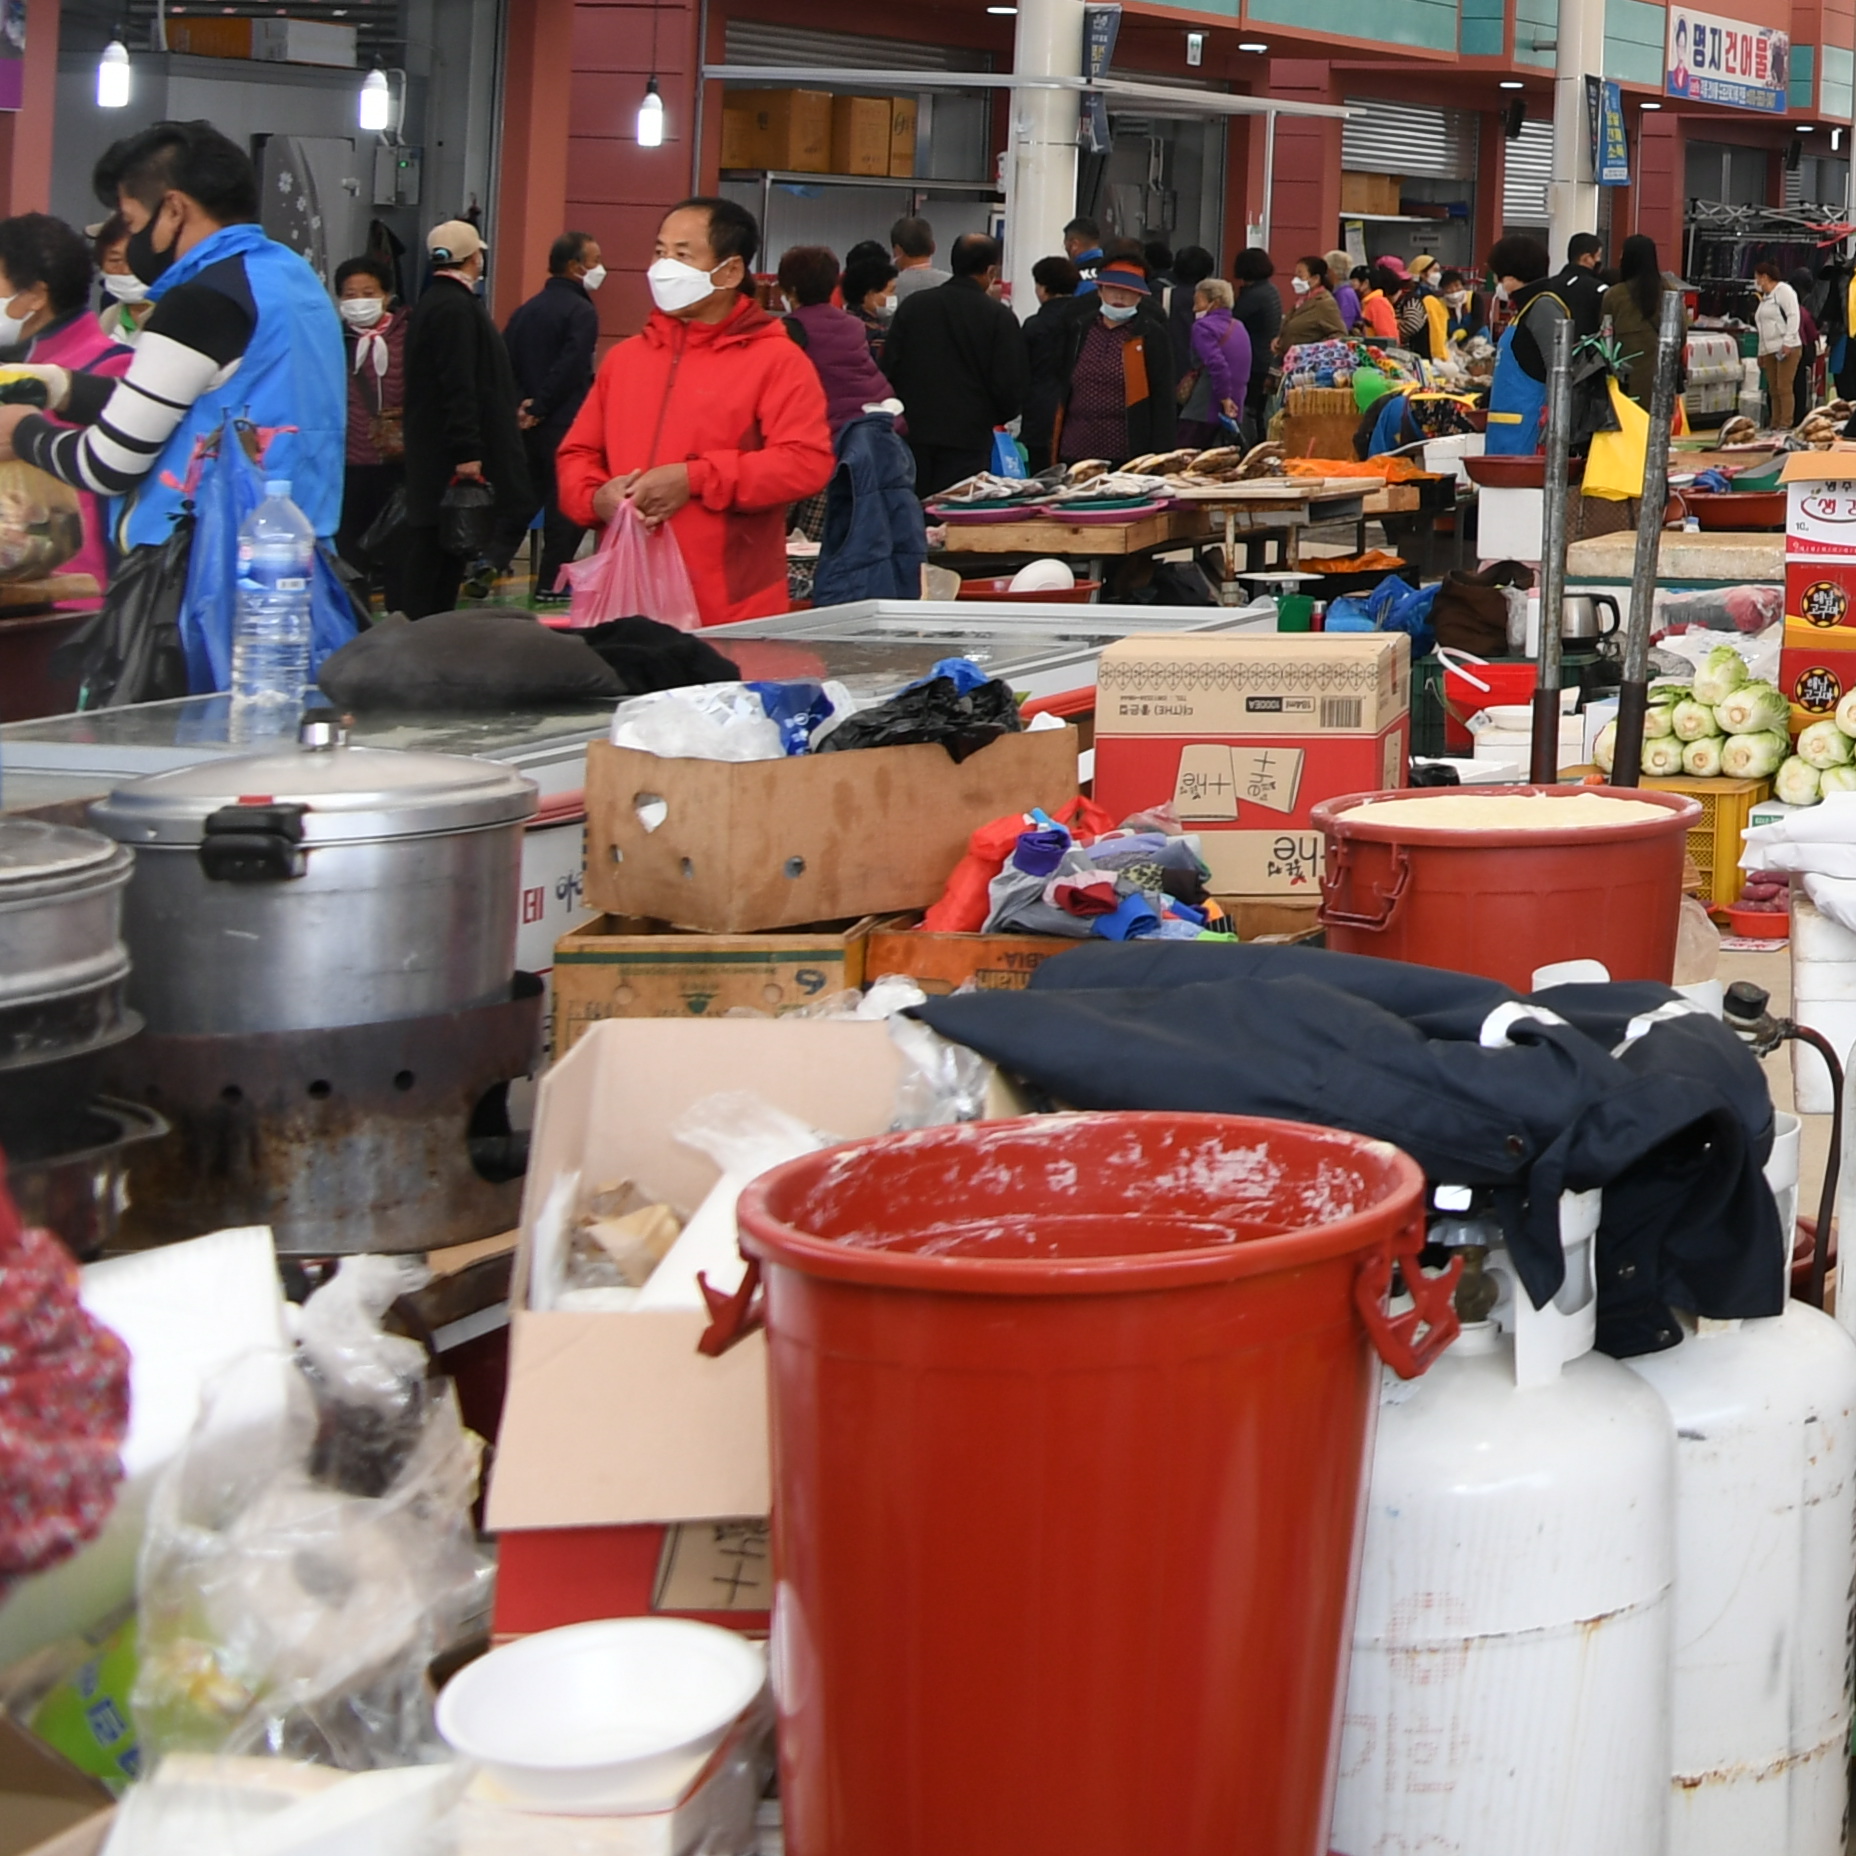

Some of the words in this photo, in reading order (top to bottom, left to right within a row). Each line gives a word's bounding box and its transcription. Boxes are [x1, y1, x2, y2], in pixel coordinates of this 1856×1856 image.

[1813, 590, 1835, 609] 해남
[1809, 604, 1840, 622] 고구마
[1806, 675, 1829, 694] 해남
[1802, 689, 1833, 706] 고구마
